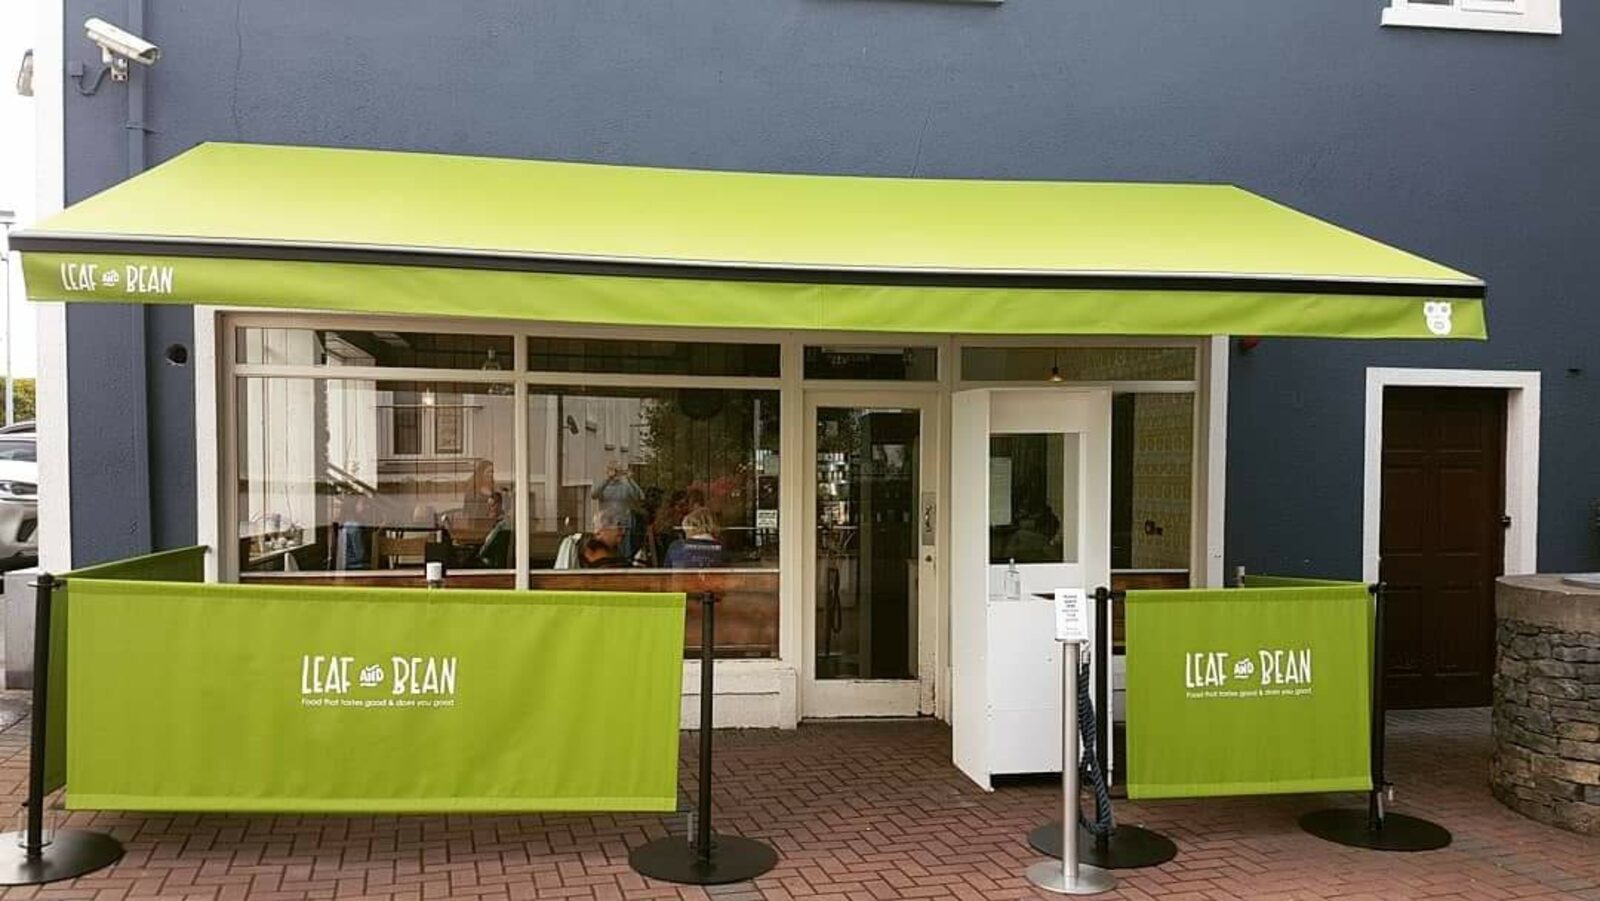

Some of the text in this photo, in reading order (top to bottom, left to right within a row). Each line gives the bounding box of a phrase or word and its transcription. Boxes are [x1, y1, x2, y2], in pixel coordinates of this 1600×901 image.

[61, 263, 98, 291] LEAF
[126, 265, 174, 293] BEAN
[301, 655, 457, 695] LEAF AND BEAN
[1186, 648, 1311, 688] LEAF AND BEAN
[301, 698, 322, 706] Food
[324, 698, 339, 706] that
[341, 698, 363, 706] tastes
[365, 698, 387, 708] good
[395, 698, 415, 706] does
[416, 699, 431, 708] you
[432, 698, 455, 708] good
